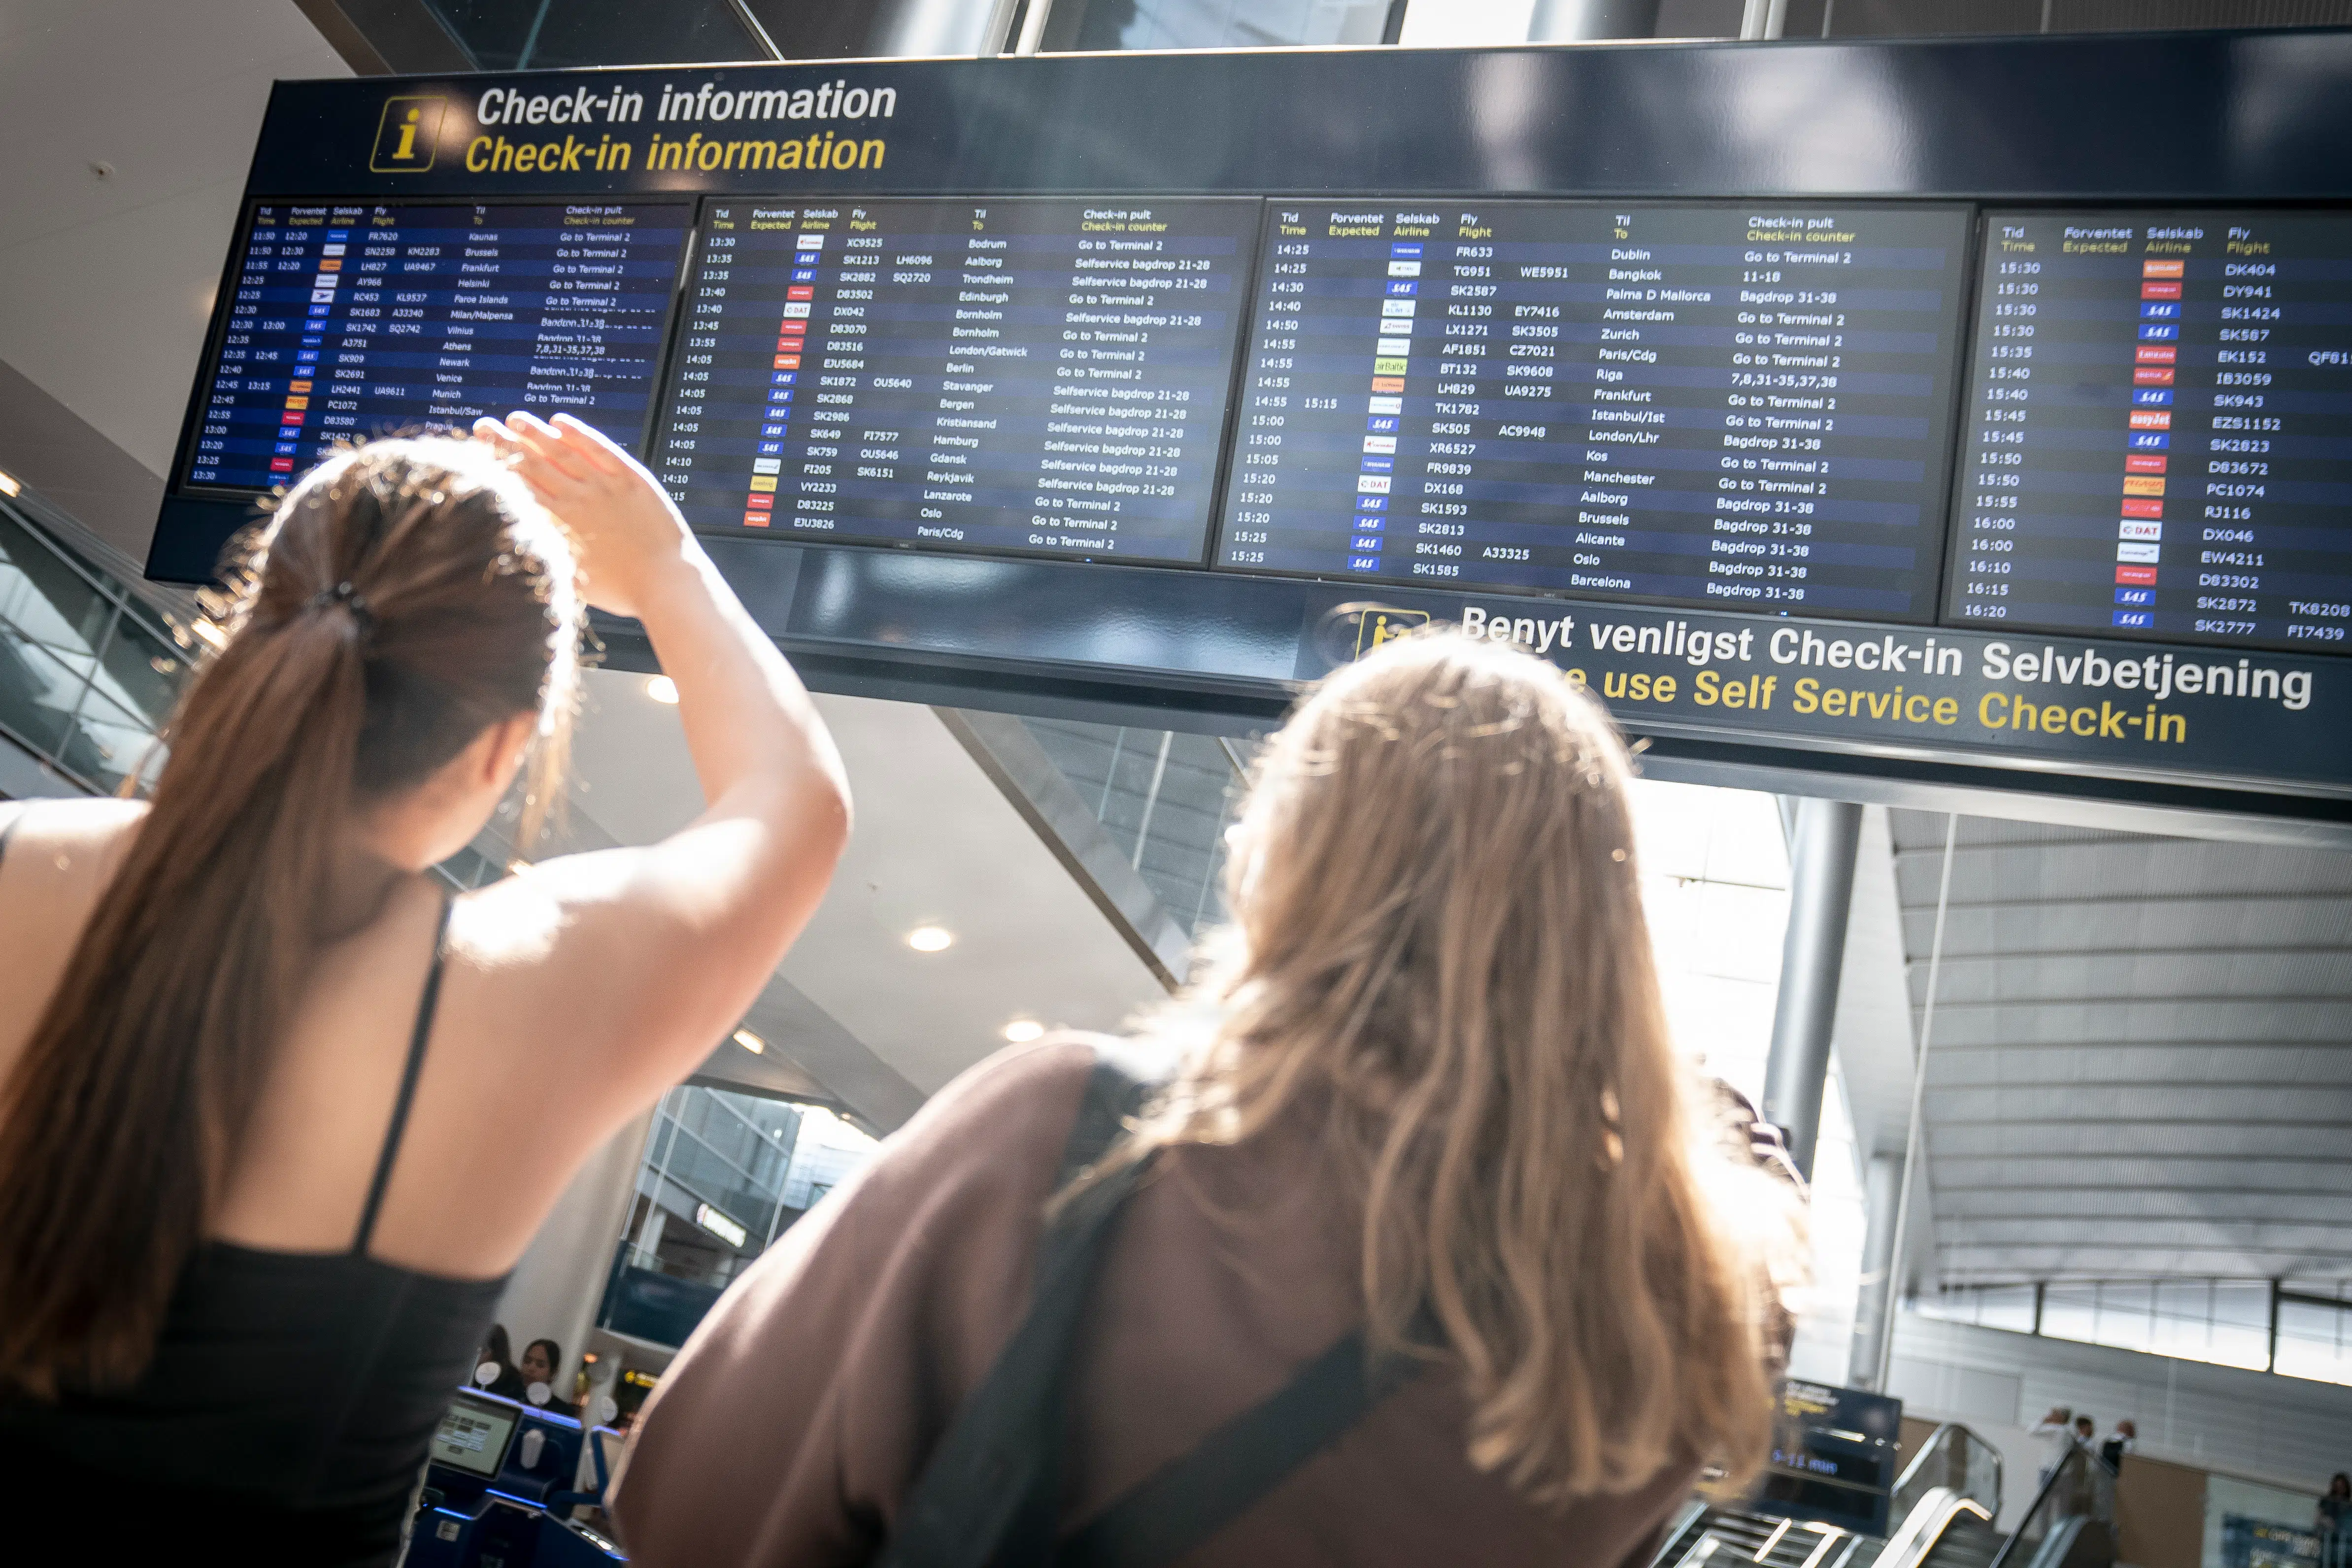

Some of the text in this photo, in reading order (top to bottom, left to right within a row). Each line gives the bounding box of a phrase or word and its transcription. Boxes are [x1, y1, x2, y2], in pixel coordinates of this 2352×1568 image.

[477, 80, 896, 125] Check-in information
[463, 131, 885, 172] Check-in information
[375, 207, 386, 215] Fly
[605, 206, 622, 215] pult
[373, 217, 395, 226] Flight
[474, 216, 483, 225] To
[1282, 212, 1478, 225] Tid Forventet Selskab Fly
[1748, 217, 1834, 229] Check-in pult
[560, 233, 572, 241] Go
[587, 233, 622, 241] Terminal
[625, 233, 630, 241] 2
[1280, 225, 1491, 238] Time Expected Airline Flight
[1747, 230, 1854, 242] Check-in counter
[969, 239, 1007, 248] Bodrum
[1278, 245, 1309, 255] 14:25
[1612, 249, 1650, 260] Dublin
[707, 254, 732, 263] 13:35
[965, 257, 1002, 267] Aalborg
[1075, 258, 1130, 268] Selfservice
[1133, 260, 1176, 270] bagdrop
[462, 264, 499, 272] Frankfurt
[2001, 262, 2275, 275] 15:30 DK404
[963, 274, 1013, 284] Trondheim
[1609, 268, 1661, 281] Bangkok
[1272, 282, 1304, 292] 14:30
[454, 295, 508, 303] Faroe Islands
[959, 292, 1008, 303] Edinburgh
[1607, 289, 1711, 301] Palma D Mallorca
[451, 311, 513, 320] Milan/Malpensa
[956, 309, 1002, 319] Bornholm
[1448, 305, 1559, 317] KL1130 EY7416
[1604, 309, 1674, 320] Amsterdam
[2146, 305, 2174, 315] SAS
[1738, 312, 1845, 326] Go to Terminal 2
[953, 327, 999, 337] Bornholm
[1446, 324, 1488, 335] LX1271
[1602, 329, 1640, 340] Zurich
[342, 338, 367, 347] A3751
[950, 346, 1028, 357] London/Gatwick
[1599, 349, 1657, 363] Paris/Cdg
[1992, 346, 2266, 363] 15:35 EK152
[439, 358, 469, 366] Newark
[946, 363, 974, 372] Berlin
[1376, 361, 1477, 374] airBaltic BT132
[437, 374, 462, 382] Venice
[1597, 369, 1623, 382] Riga
[248, 382, 270, 390] 13:15
[943, 381, 993, 393] Stavanger
[433, 390, 461, 398] Munich
[1594, 389, 1651, 401] Frankfurt
[940, 399, 974, 410] Bergen
[1305, 398, 1337, 409] 15:15
[429, 406, 483, 416] Istanbul/Saw
[1592, 409, 1665, 423] Istanbul/Ist
[937, 417, 997, 429] Kristiansand
[673, 423, 899, 441] 14:05 FI7577
[1589, 430, 1659, 443] London/Lhr
[934, 435, 978, 448] Hamburg
[1430, 443, 1476, 454] XR6527
[666, 457, 692, 466] 14:10
[930, 453, 967, 464] Gdansk
[1587, 451, 1608, 462] Kos
[928, 471, 974, 483] Reykjavik
[1244, 473, 1388, 489] 15:20 DAT
[1584, 471, 1655, 484] Manchester
[924, 490, 972, 501] Lanzarote
[1581, 491, 1628, 506] Aalborg
[1977, 496, 2017, 508] 15:55
[921, 508, 942, 518] Oslo
[1579, 512, 1629, 525] Brussels
[918, 526, 964, 540] Paris/Cdg
[2135, 526, 2158, 536] DAT
[1576, 533, 1625, 546] Alicante
[1235, 532, 1529, 560] 15:25 A33325
[1352, 558, 1375, 568] SAS
[1574, 554, 1600, 565] Oslo
[2201, 551, 2263, 566] EW4211
[1970, 561, 2011, 573] 16:10
[1572, 574, 1631, 589] Barcelona
[1707, 583, 1761, 598] Bagdrop
[1968, 583, 2008, 596] 16:15
[1966, 604, 2344, 639] 16:20 SAS SK2777 FI7439
[1462, 606, 2313, 710] Benyt venligst Check-in Selvbetjening
[1604, 671, 1677, 703] use
[1693, 669, 1777, 710] Self
[1792, 677, 1959, 725] Service
[1978, 691, 2186, 743] Check-in
